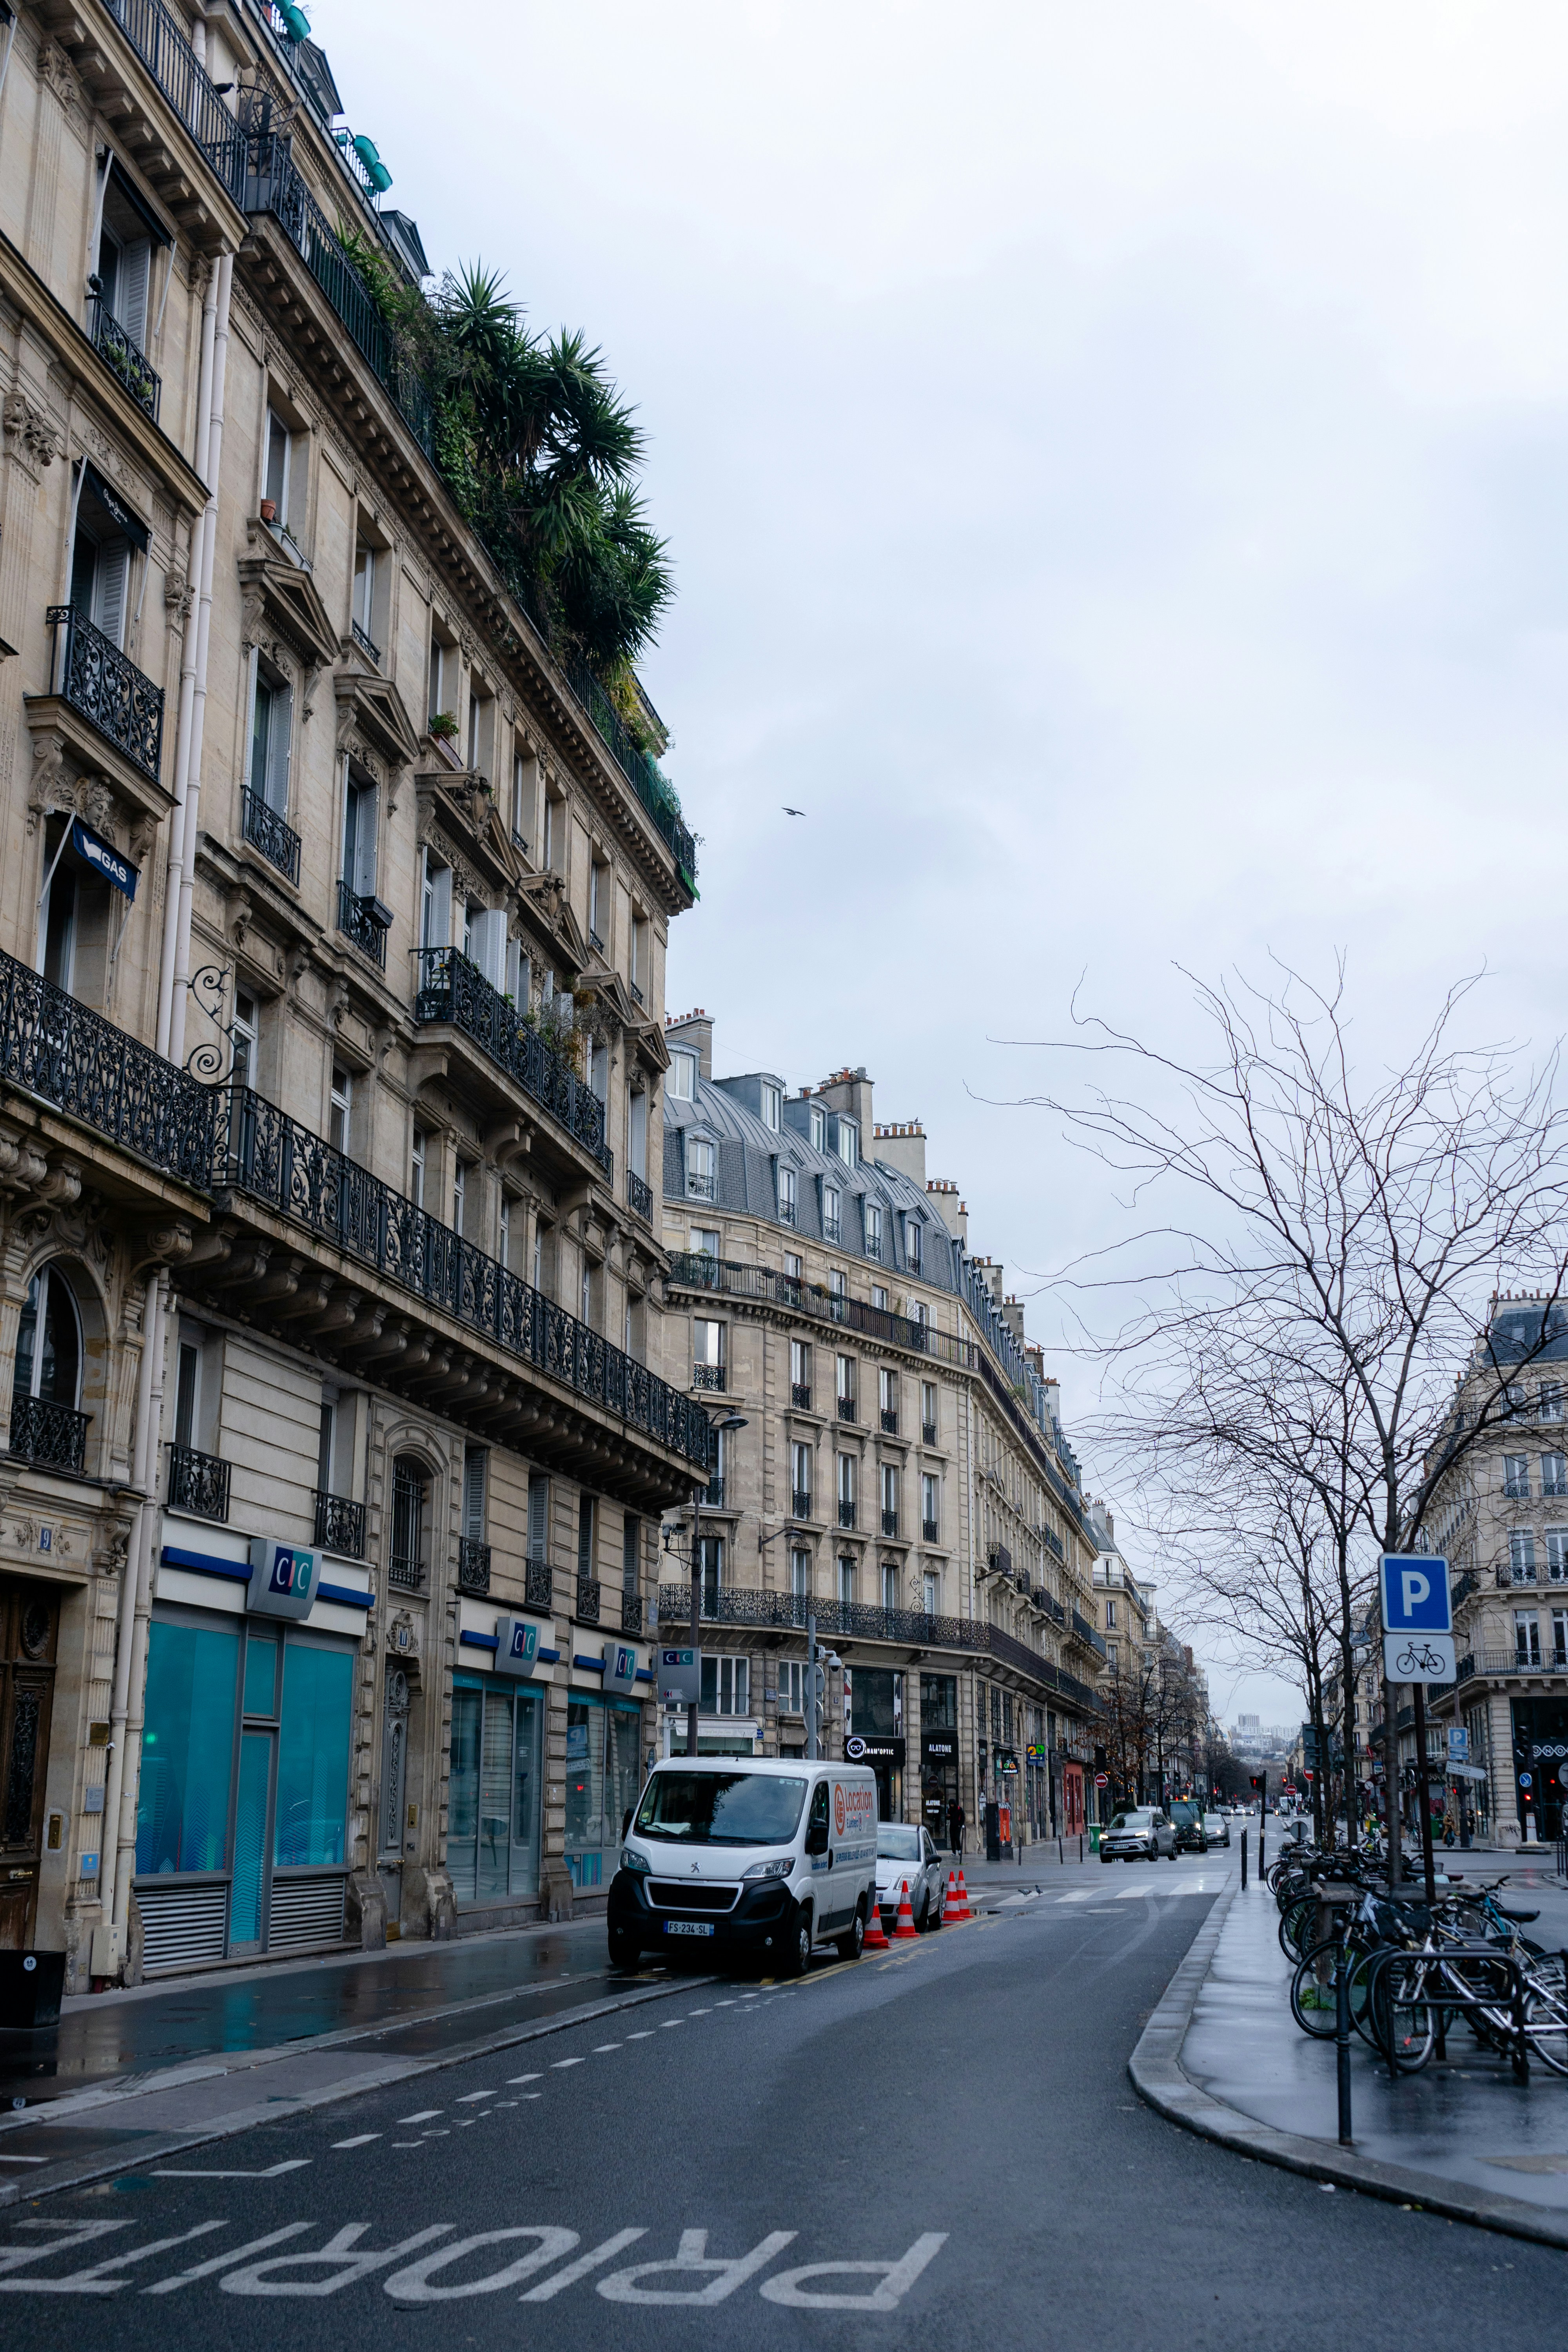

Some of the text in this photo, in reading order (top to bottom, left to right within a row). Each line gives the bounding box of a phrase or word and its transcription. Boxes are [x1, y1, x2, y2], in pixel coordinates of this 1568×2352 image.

[103, 488, 128, 522] Pepe Jeans
[102, 852, 127, 882] GAS
[44, 1530, 49, 1548] 9
[276, 1557, 309, 1590] CIC
[1401, 1571, 1430, 1616] P
[514, 1630, 534, 1654] CIC
[619, 1654, 633, 1674] CIC
[666, 1653, 690, 1663] CIC
[1454, 1731, 1462, 1744] P
[929, 1744, 952, 1753] ALATONE
[844, 1785, 873, 1812] Location
[836, 1853, 838, 1863] LE
[669, 1923, 707, 1934] FS-234-SL
